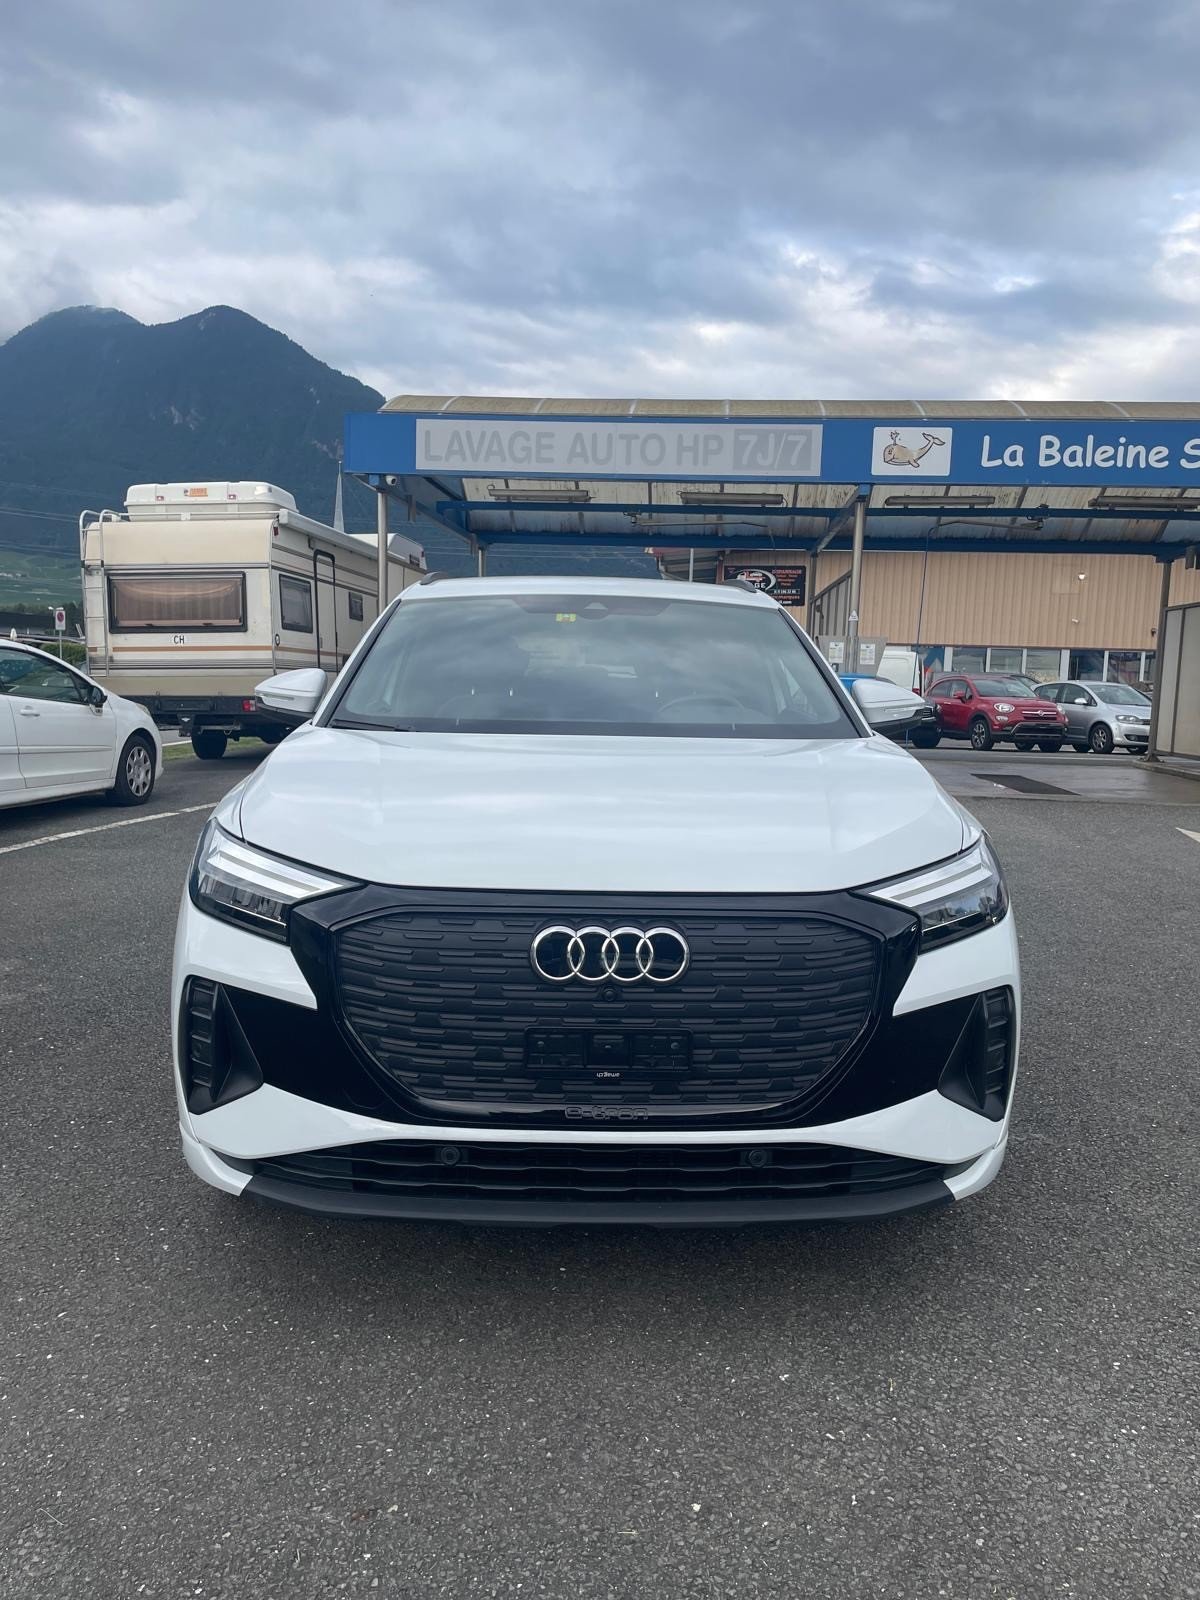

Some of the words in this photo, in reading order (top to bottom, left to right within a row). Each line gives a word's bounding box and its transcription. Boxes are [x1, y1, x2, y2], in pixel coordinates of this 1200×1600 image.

[424, 429, 555, 465] LAVAGE
[566, 431, 666, 467] AUTO
[676, 433, 724, 467] HP
[738, 432, 808, 469] 7J/7
[981, 435, 1024, 468] La
[1038, 434, 1169, 469] Baleine
[1179, 438, 1200, 469] S
[173, 635, 185, 644] CH
[564, 1104, 649, 1120] e-tron
